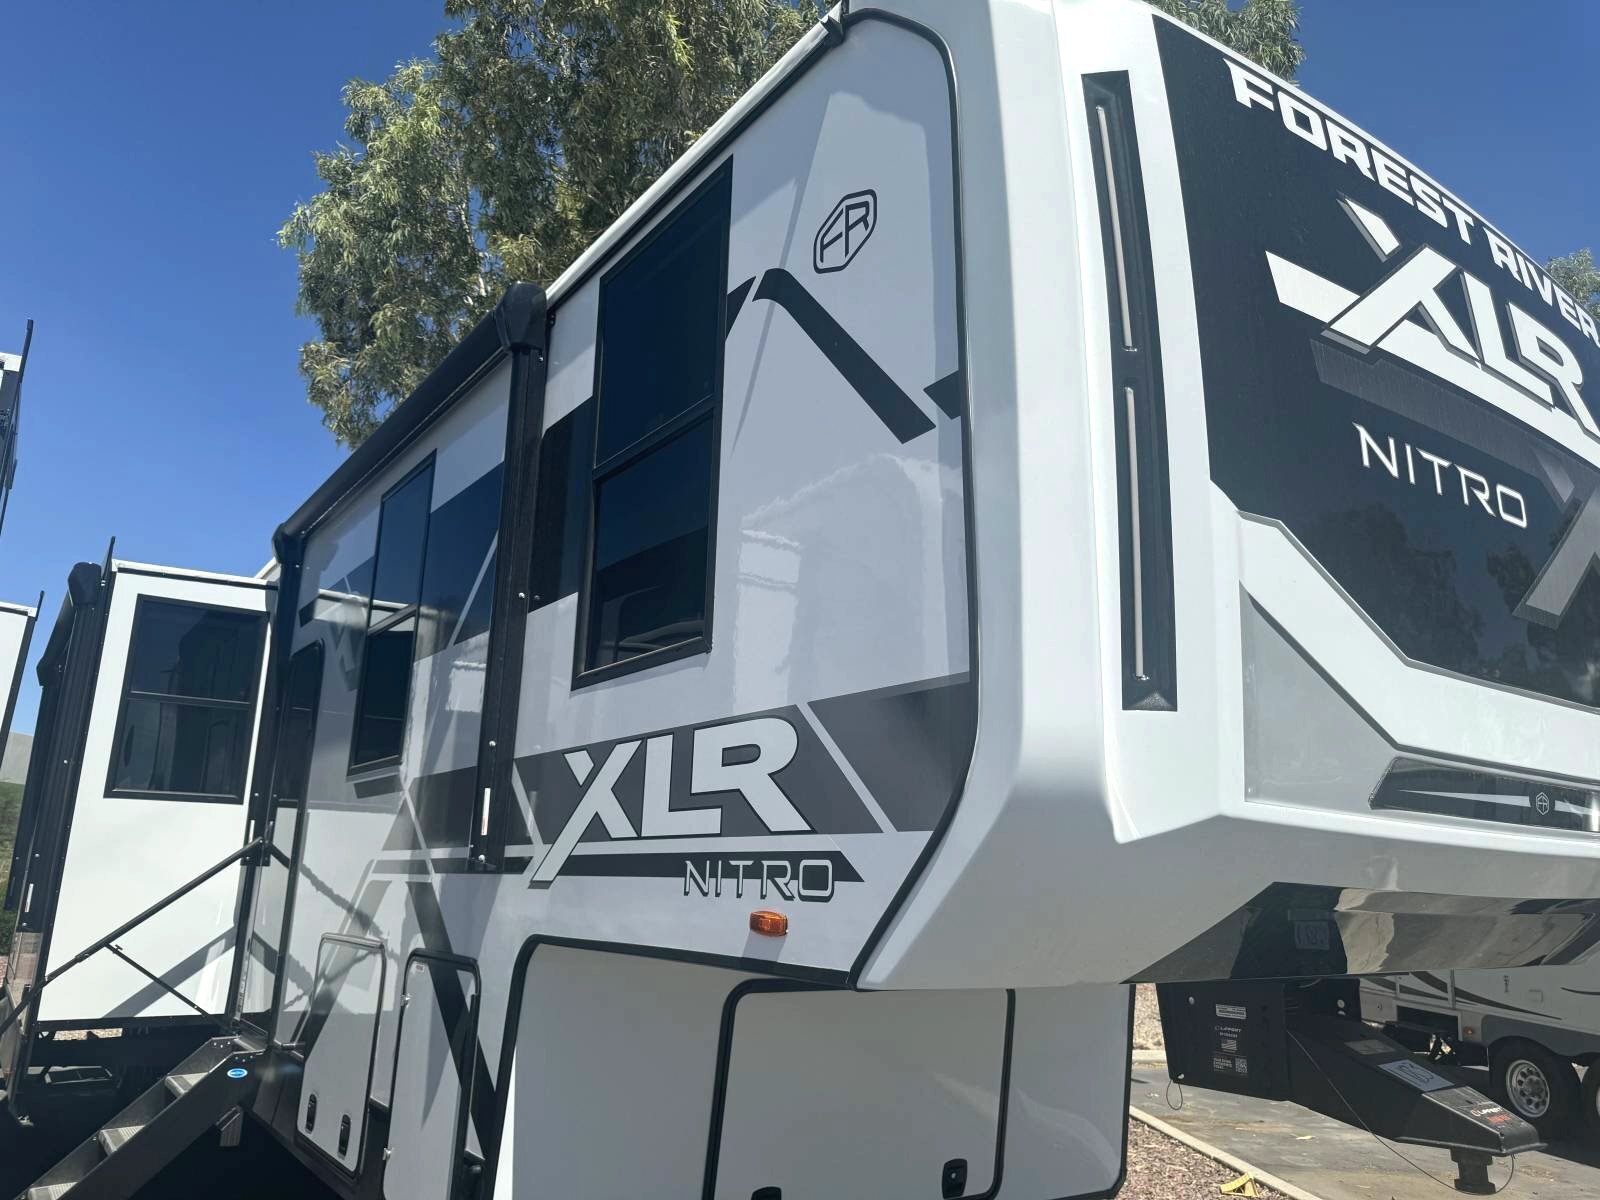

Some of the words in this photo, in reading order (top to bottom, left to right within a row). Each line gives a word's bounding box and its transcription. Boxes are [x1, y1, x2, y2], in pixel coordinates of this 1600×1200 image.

[1223, 57, 1475, 246] FOREST
[1482, 225, 1600, 349] RIVER
[1312, 196, 1600, 442] XLR
[1352, 421, 1528, 529] NITRO
[529, 716, 816, 888] XLR
[683, 858, 835, 903] NITRO
